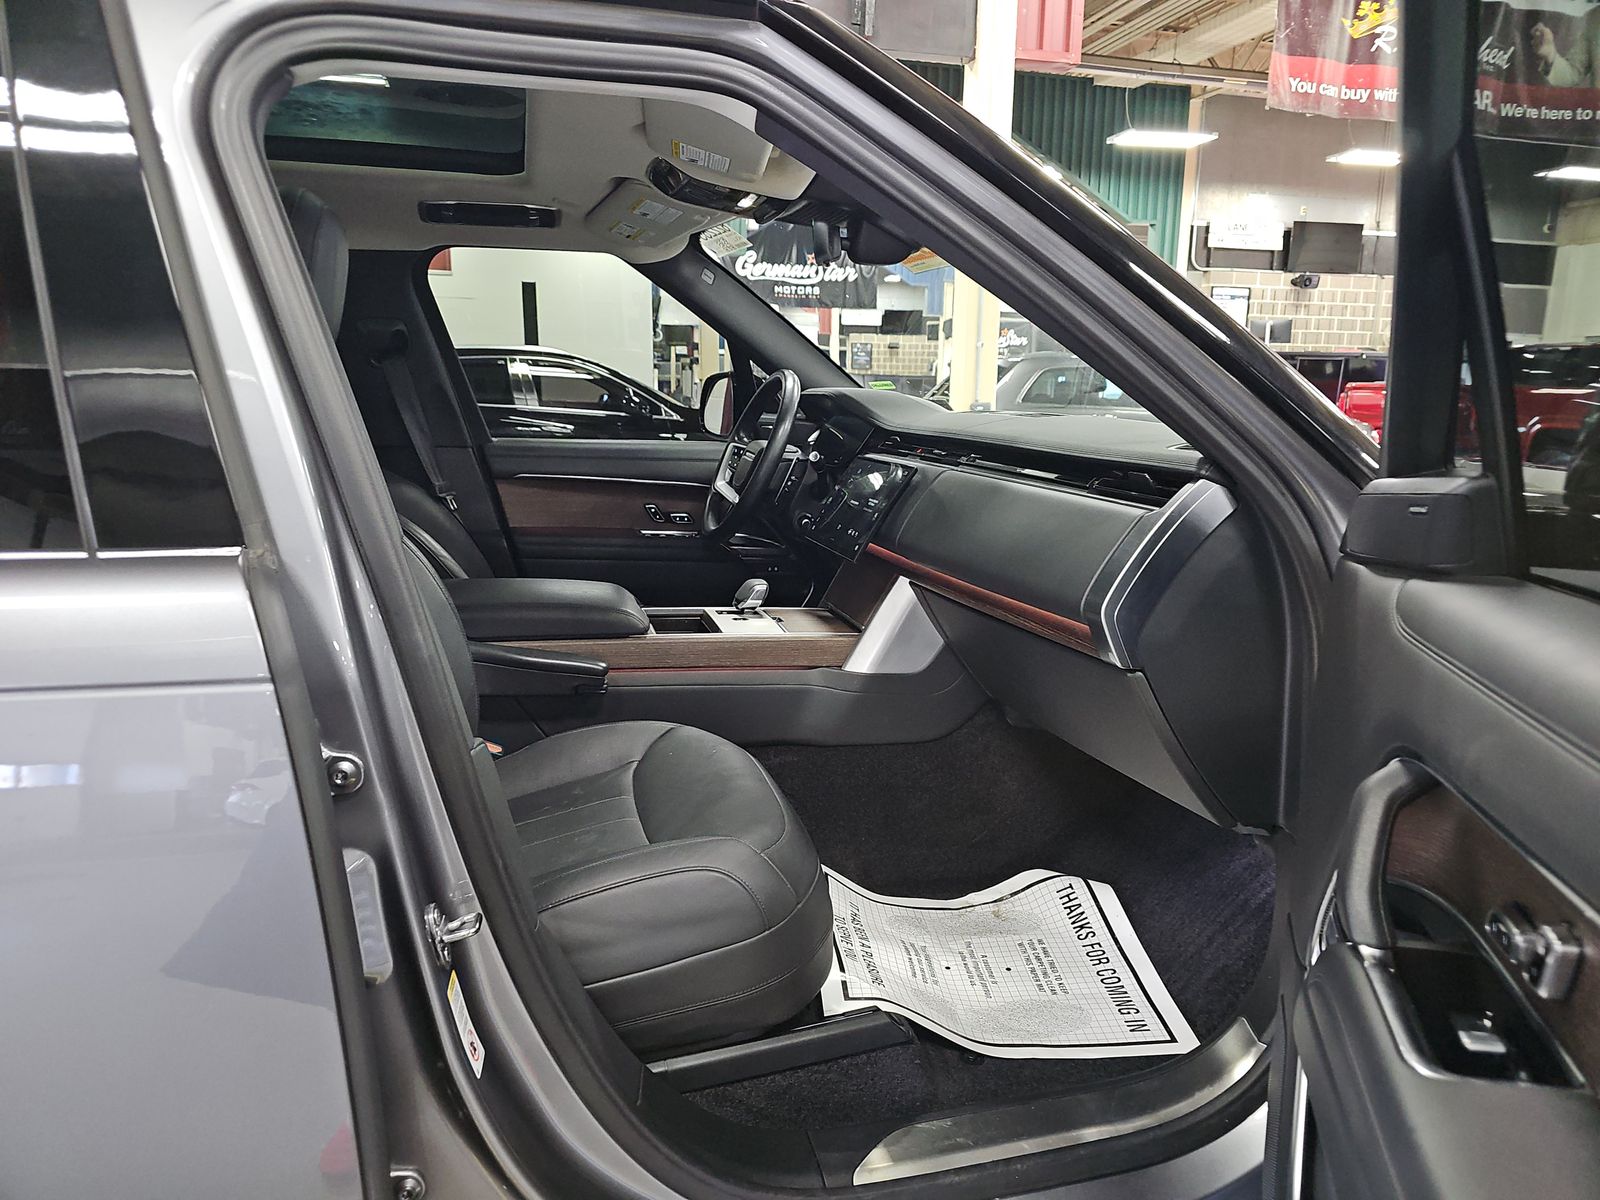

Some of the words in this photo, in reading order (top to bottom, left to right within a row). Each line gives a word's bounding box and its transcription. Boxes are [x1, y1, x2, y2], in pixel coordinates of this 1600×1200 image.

[1288, 77, 1316, 94] You
[1318, 83, 1339, 98] can
[1340, 84, 1371, 103] buy
[1500, 103, 1539, 119] We're
[1540, 106, 1573, 120] here
[1575, 107, 1593, 120] to
[774, 285, 820, 295] MOTORS
[848, 900, 860, 913] IT
[834, 914, 847, 925] TO
[849, 909, 864, 927] HAS
[853, 925, 871, 943] BEEN
[858, 940, 872, 949] A
[1027, 939, 1038, 951] YOUR
[1037, 938, 1046, 946] WE
[1040, 946, 1052, 959] HAVE
[1056, 883, 1097, 941] THANKS
[1081, 942, 1111, 967] FOR
[1096, 968, 1140, 1016] COMING
[1123, 1019, 1151, 1033] IN
[1023, 954, 1034, 967] THIS
[1032, 952, 1051, 980] CARPETING
[1046, 959, 1059, 974] TRIED
[860, 949, 886, 989] PLEASURE
[1027, 966, 1042, 982] PAPER
[1053, 974, 1063, 982] TO
[1044, 980, 1058, 996] CLEAN
[1057, 982, 1070, 995] KEEP
